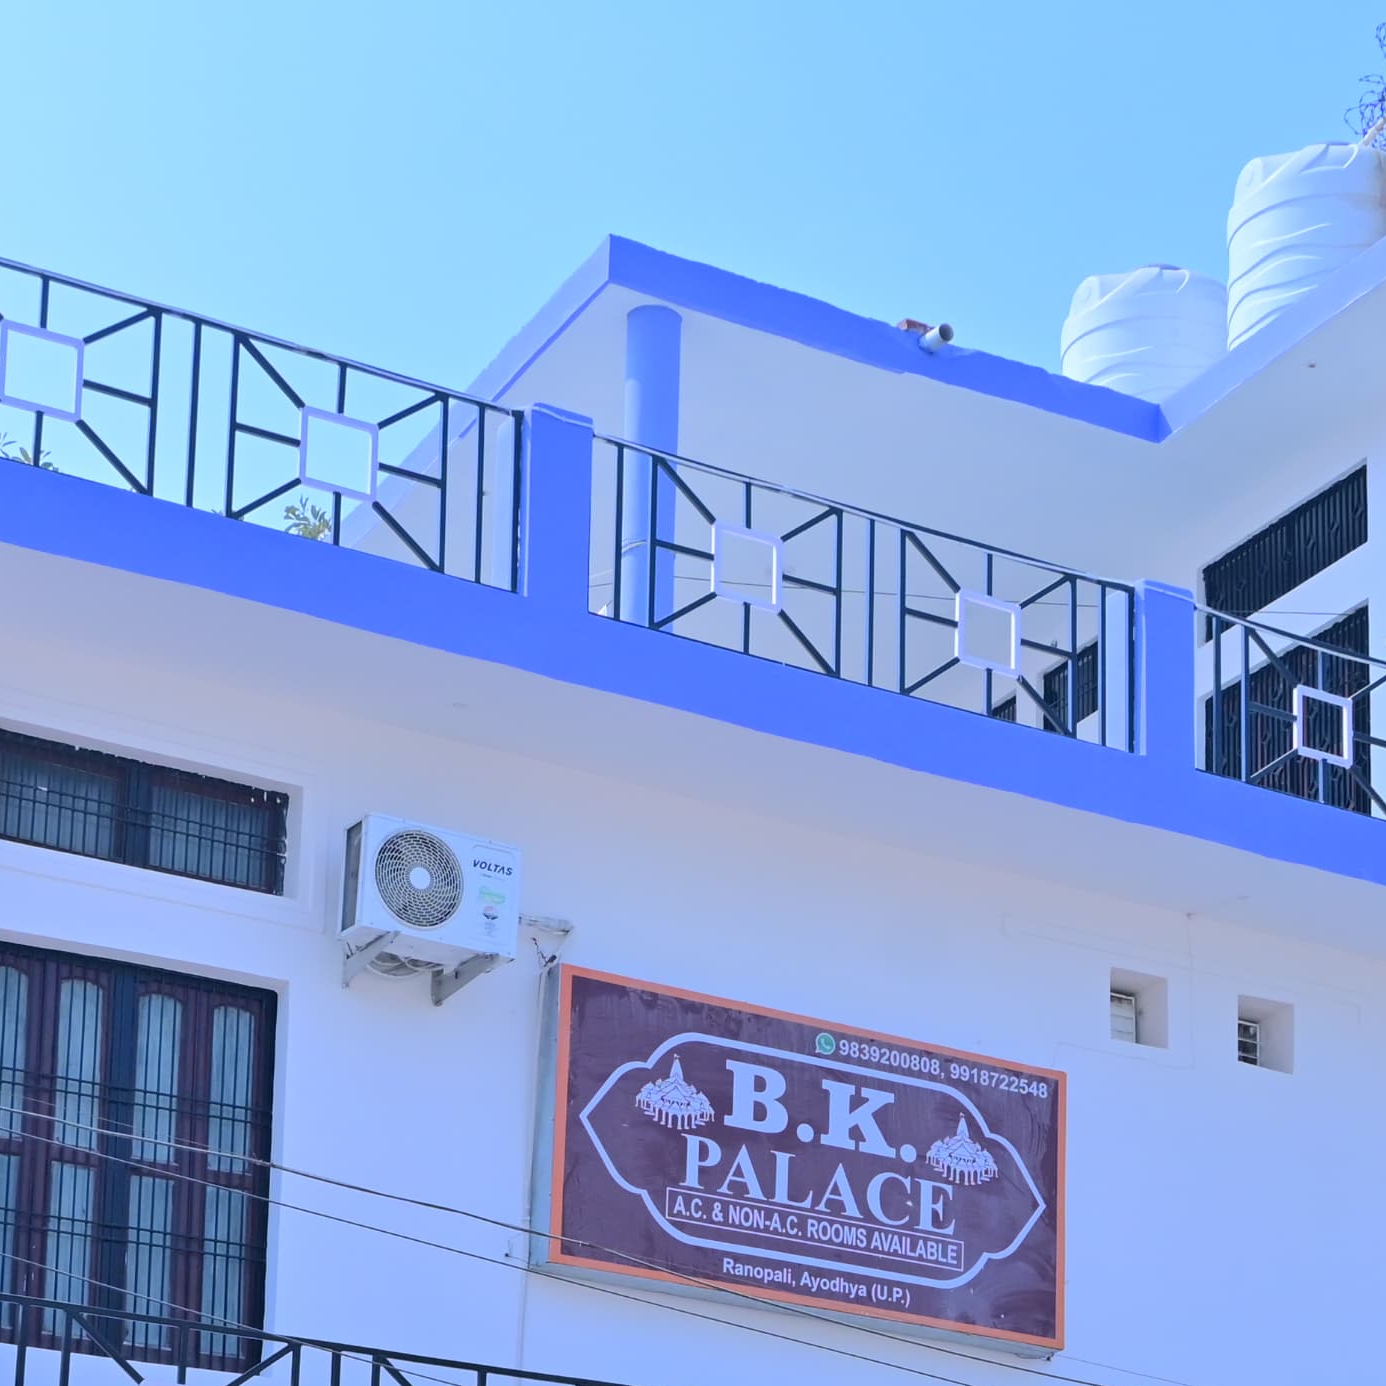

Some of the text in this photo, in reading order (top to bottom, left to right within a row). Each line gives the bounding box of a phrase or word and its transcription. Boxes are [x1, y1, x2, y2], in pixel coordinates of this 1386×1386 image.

[472, 859, 513, 876] VOLTAS
[838, 1039, 1048, 1098] 9839200808, 9918722548
[723, 1059, 917, 1164] B.K.
[679, 1133, 956, 1235] PALACE
[673, 1195, 958, 1265] A.C. & NON-A.C. ROOMS AVAILABLE
[723, 1257, 911, 1308] Ranopali, Ayodhya (U.P.)
